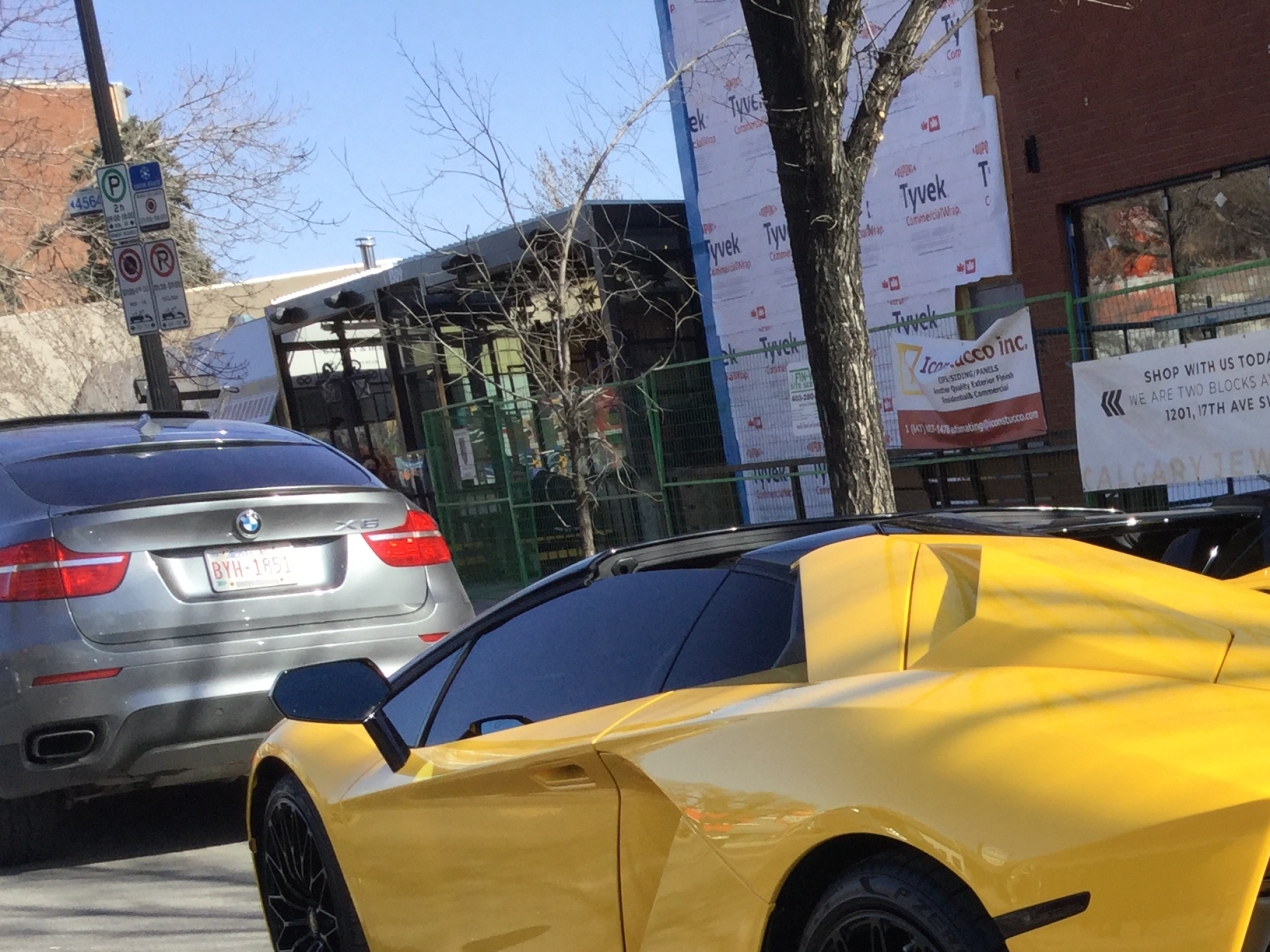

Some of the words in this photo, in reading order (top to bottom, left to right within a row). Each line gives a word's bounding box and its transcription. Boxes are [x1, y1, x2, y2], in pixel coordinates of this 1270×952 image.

[899, 174, 948, 214] Tyvek
[763, 221, 787, 250] Tyv
[971, 376, 997, 389] Exterior
[997, 371, 1015, 383] Finish
[1144, 366, 1179, 383] SHOP
[1185, 361, 1216, 377] WITH
[1219, 357, 1235, 371] US
[1129, 391, 1147, 406] WE
[1151, 386, 1174, 402] ARE
[1177, 383, 1204, 399] TWO
[1208, 375, 1257, 395] BLOCKS
[1165, 405, 1196, 422] 1201,
[1198, 401, 1226, 417] 17TH
[1230, 397, 1254, 413] AVE
[1083, 455, 1202, 491] CALGARY
[333, 518, 380, 532] X6
